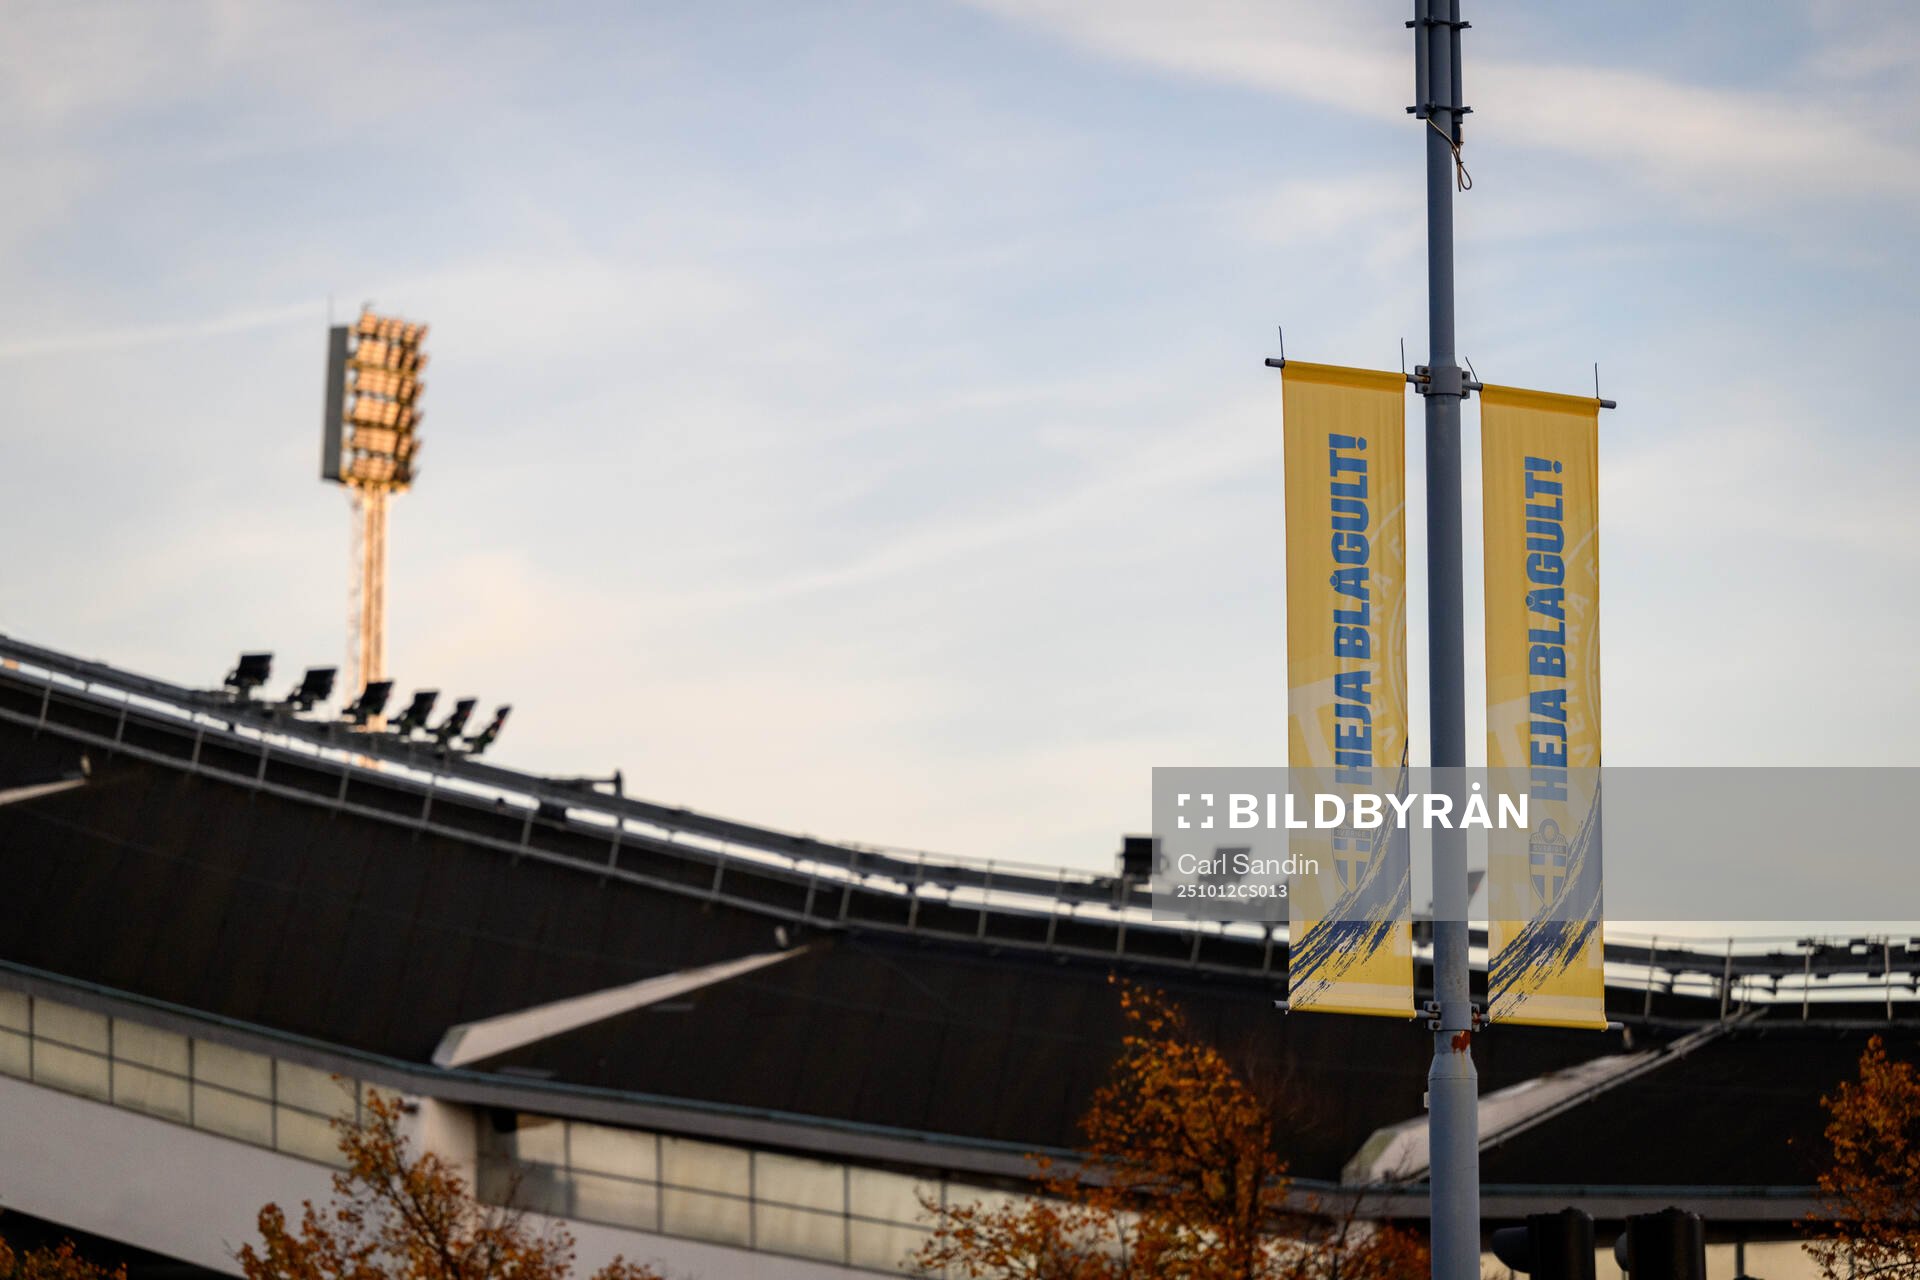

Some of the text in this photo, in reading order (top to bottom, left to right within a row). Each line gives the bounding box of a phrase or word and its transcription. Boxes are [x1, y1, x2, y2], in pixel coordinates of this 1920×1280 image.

[1329, 433, 1372, 785] HEJA BLÅGULT!
[1524, 457, 1568, 801] HEJA BLÅGULT!
